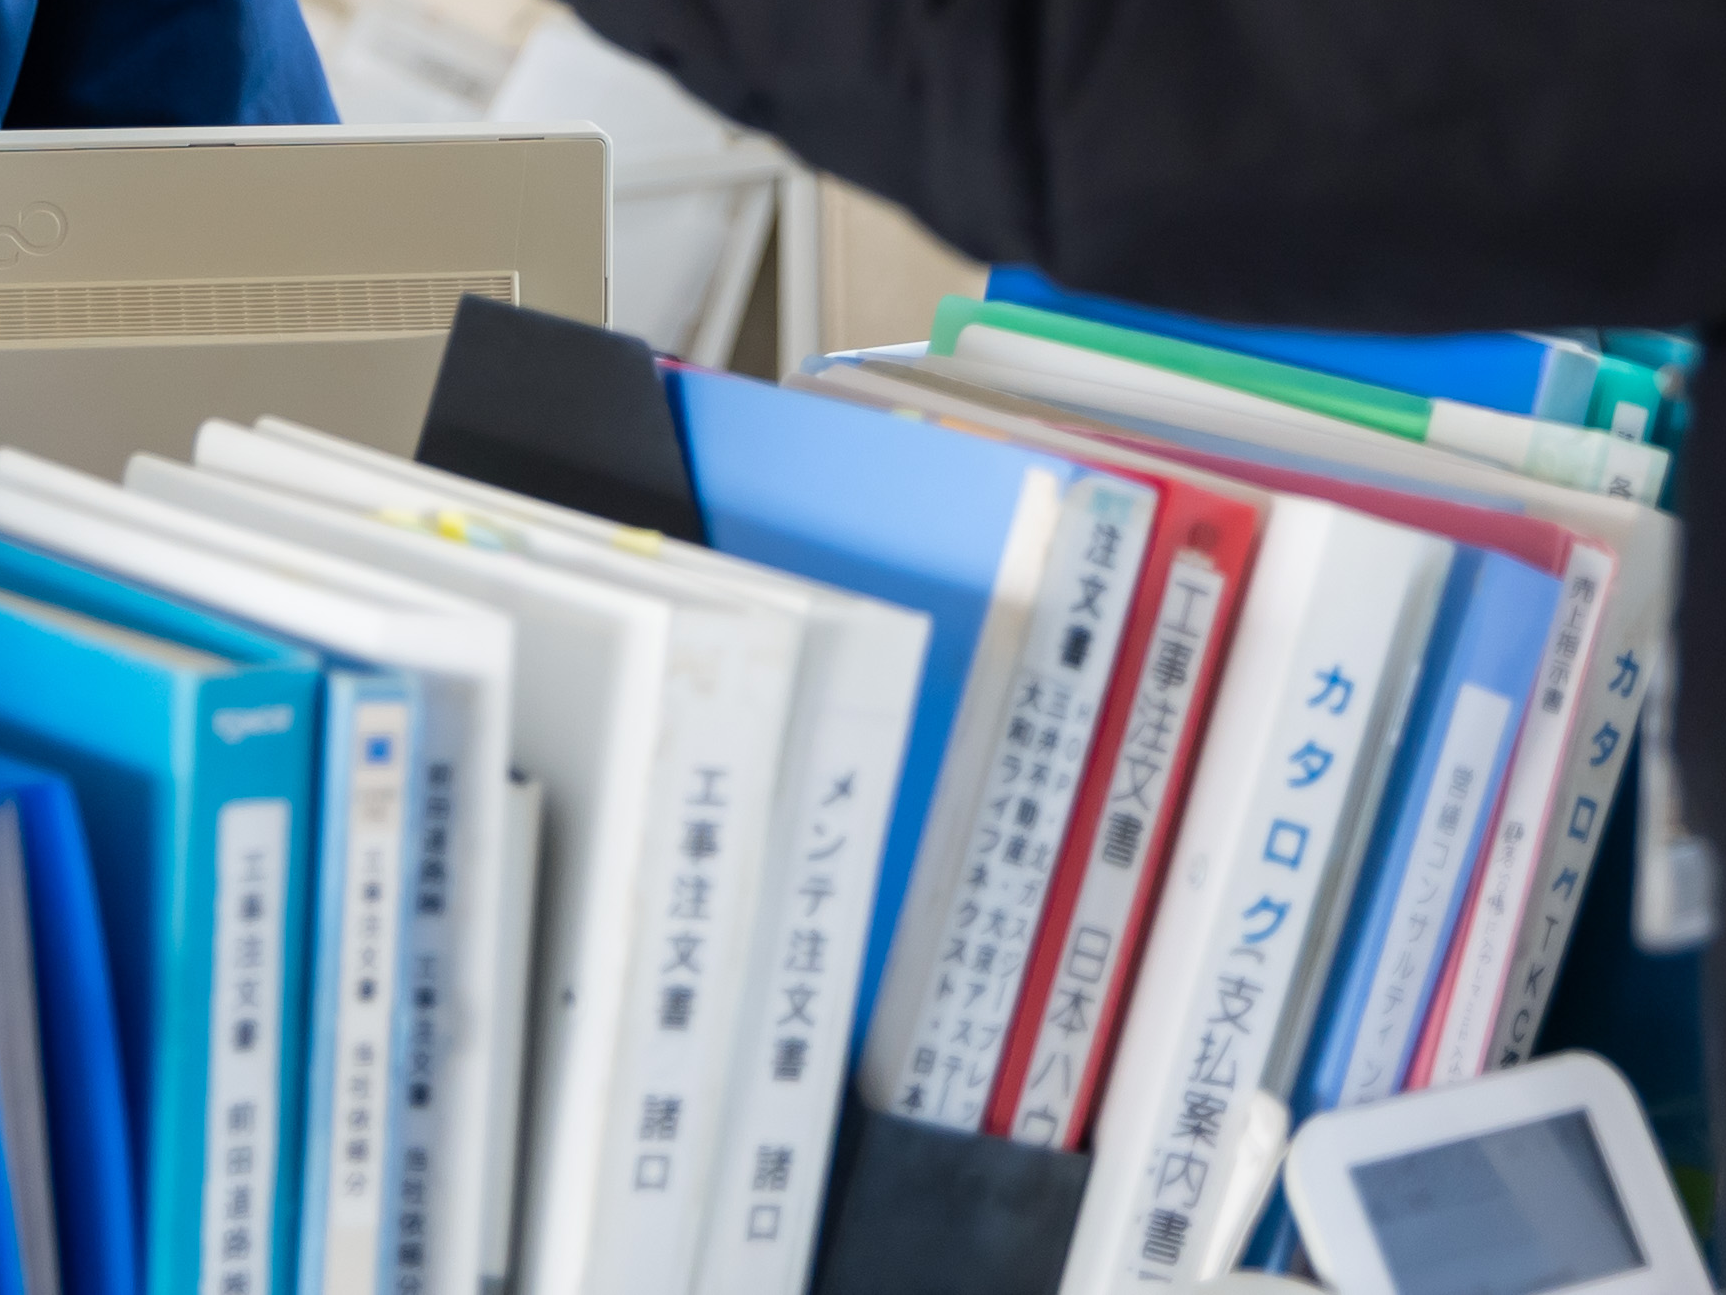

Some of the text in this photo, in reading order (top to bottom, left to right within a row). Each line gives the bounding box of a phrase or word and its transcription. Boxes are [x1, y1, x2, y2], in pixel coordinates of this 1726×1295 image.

[1060, 522, 1123, 672] 注文書
[1101, 582, 1211, 870] 工事注文書
[633, 766, 730, 1192] 工事注文書 諸口
[746, 768, 858, 1242] メンテ注文書 諸口
